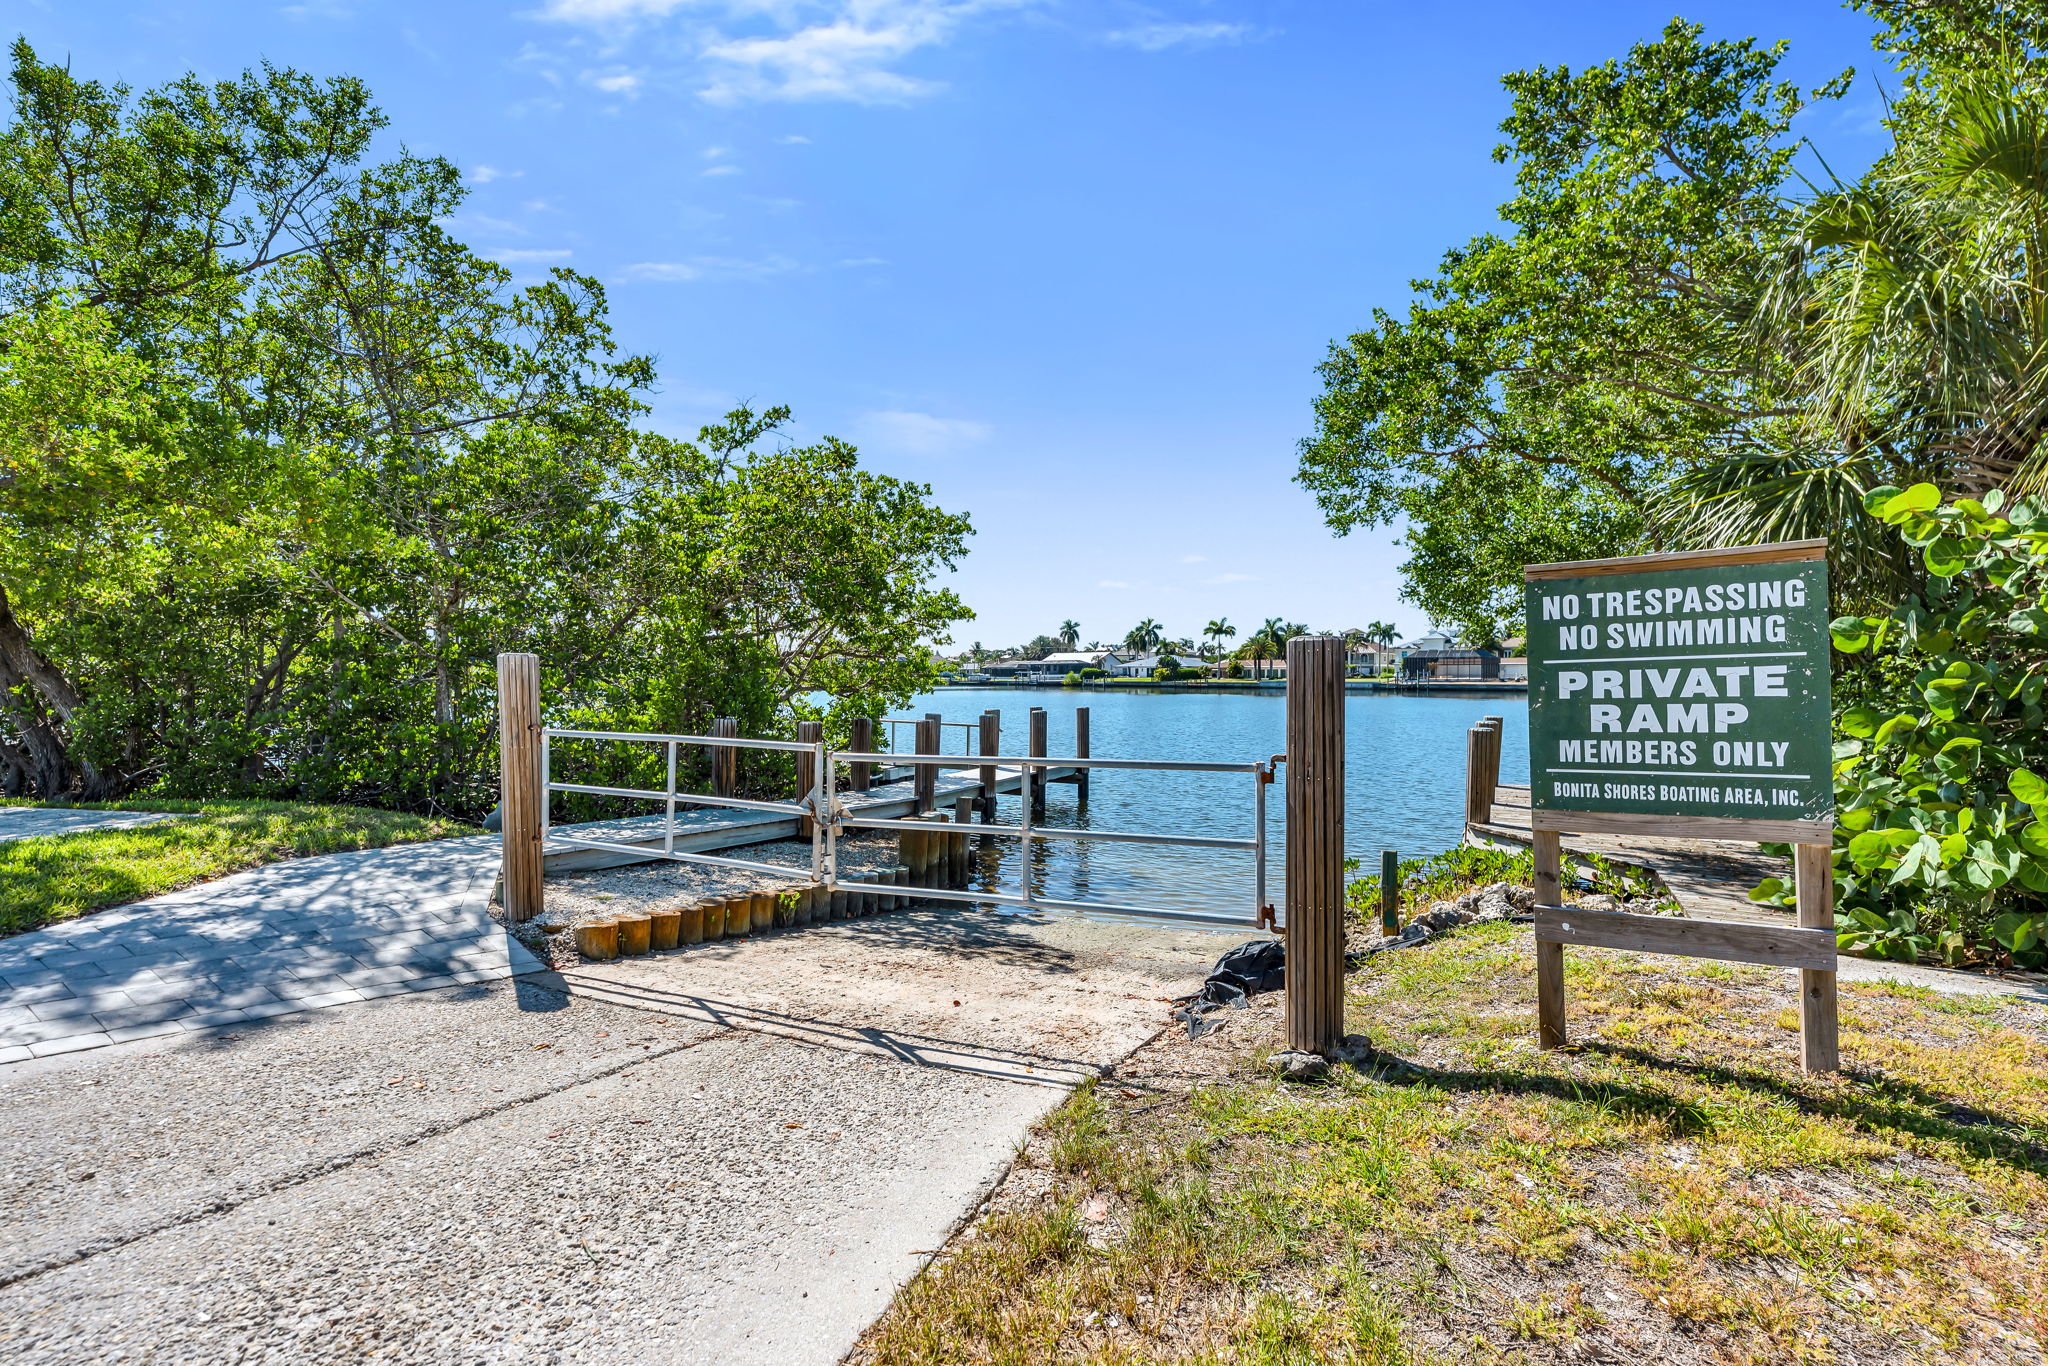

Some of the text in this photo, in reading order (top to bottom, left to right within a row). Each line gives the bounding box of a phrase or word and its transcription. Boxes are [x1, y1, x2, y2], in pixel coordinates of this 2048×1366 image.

[1543, 579, 1805, 620] NO TRESPASSING
[1559, 615, 1786, 650] NO SWIMMING
[1558, 665, 1788, 700] PRIVATE
[1590, 703, 1748, 733] RAMP
[1559, 739, 1789, 767] MEMBERS ONLY
[1554, 782, 1804, 807] BONITA SHORES BOATING AREA, INC.
